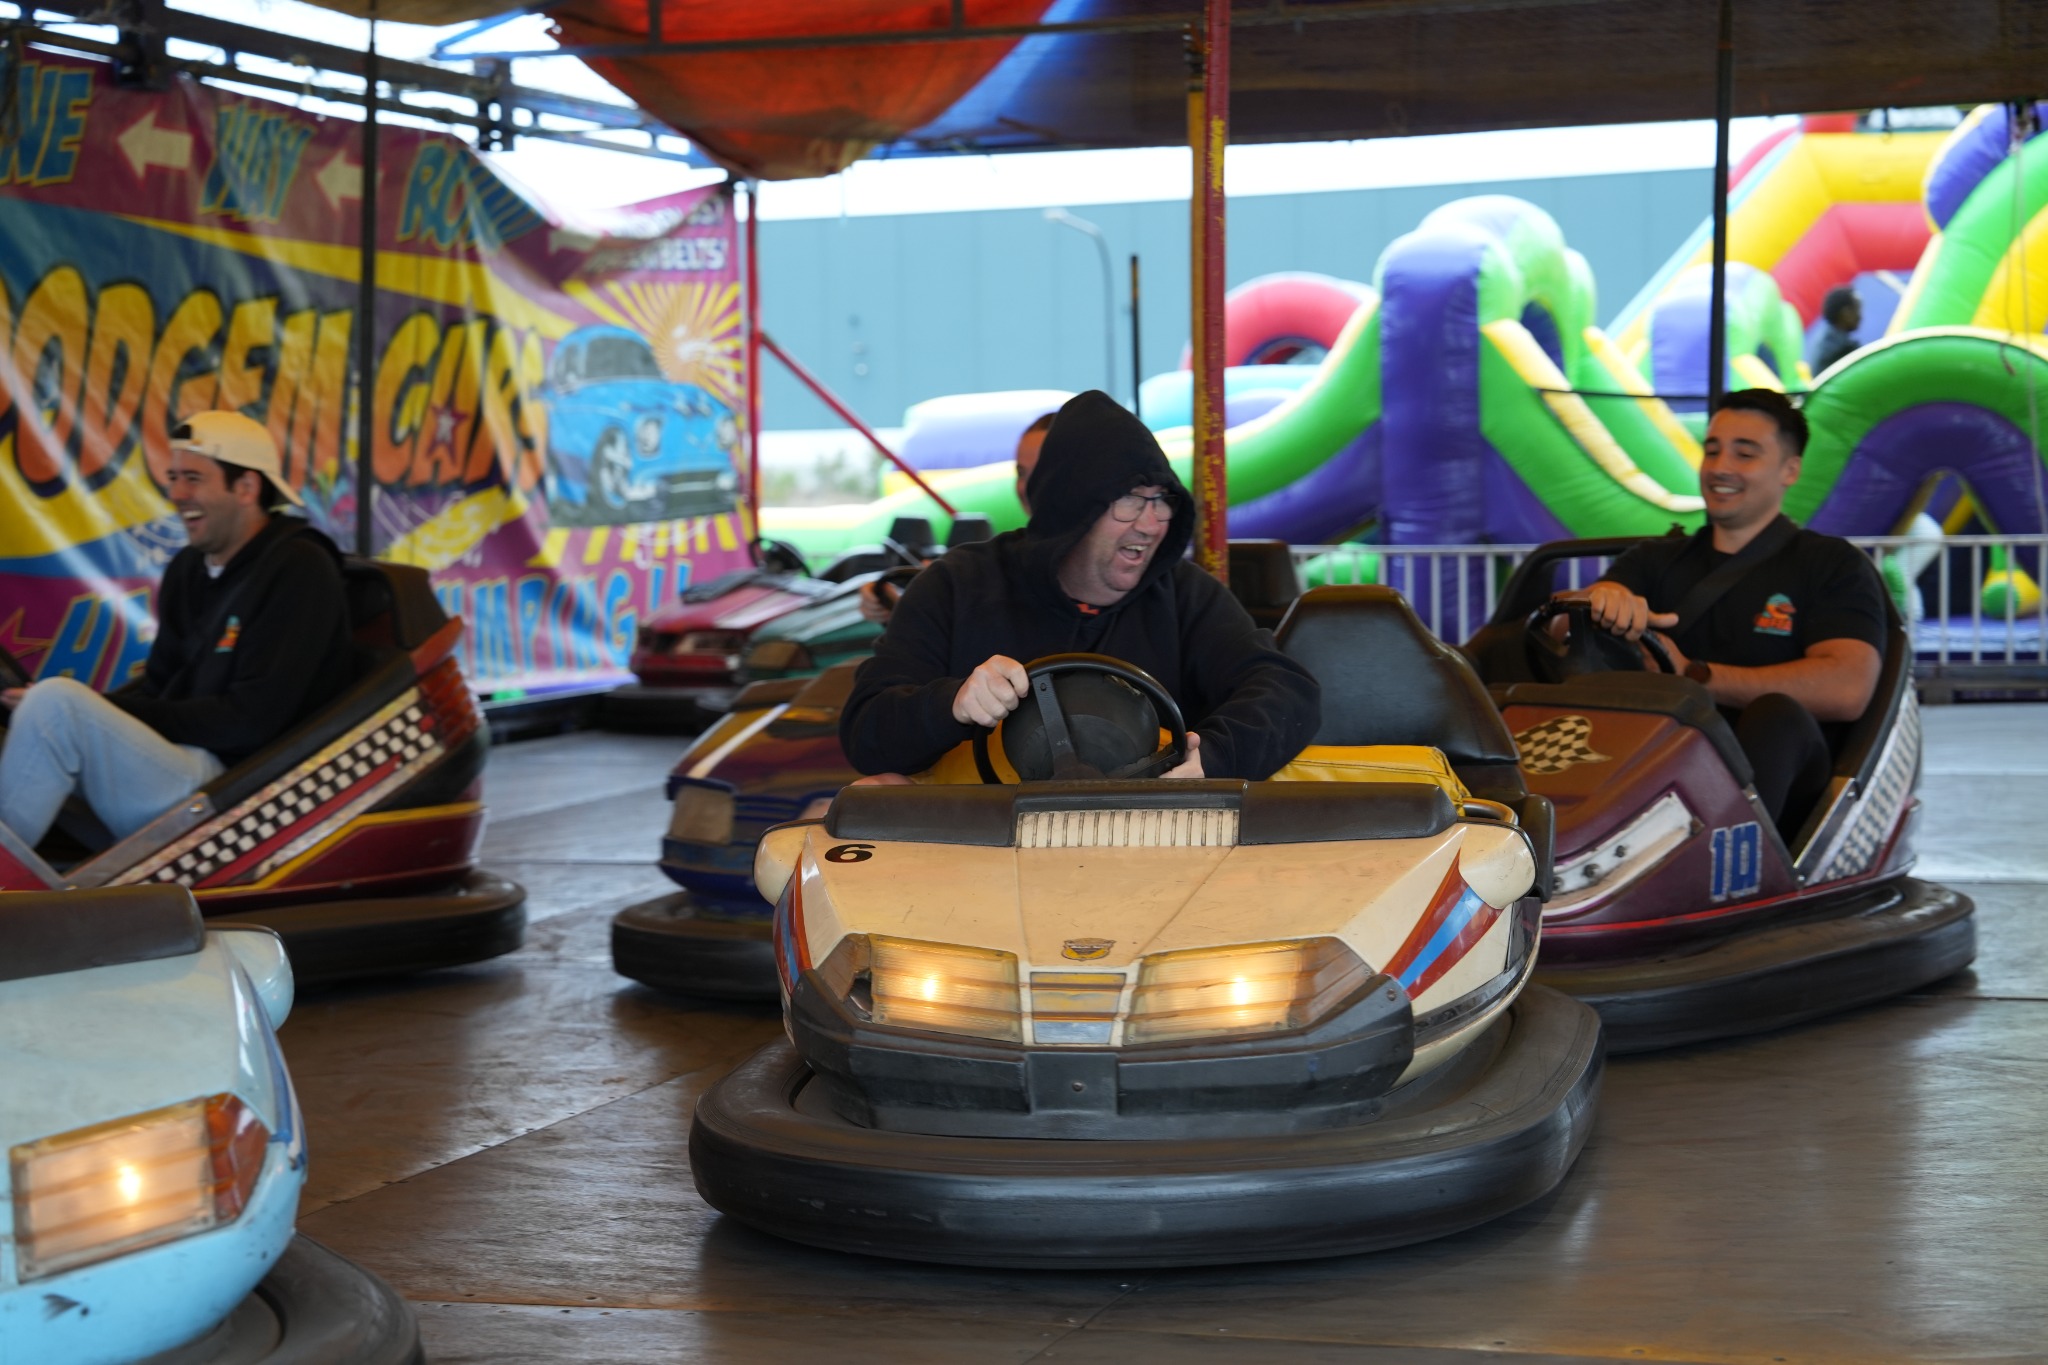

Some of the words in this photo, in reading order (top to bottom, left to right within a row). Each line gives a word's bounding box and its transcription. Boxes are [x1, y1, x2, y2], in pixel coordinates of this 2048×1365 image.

[0, 56, 96, 187] NE
[0, 264, 353, 495] ODGEM
[824, 843, 877, 863] 6
[1709, 821, 1763, 901] 10
